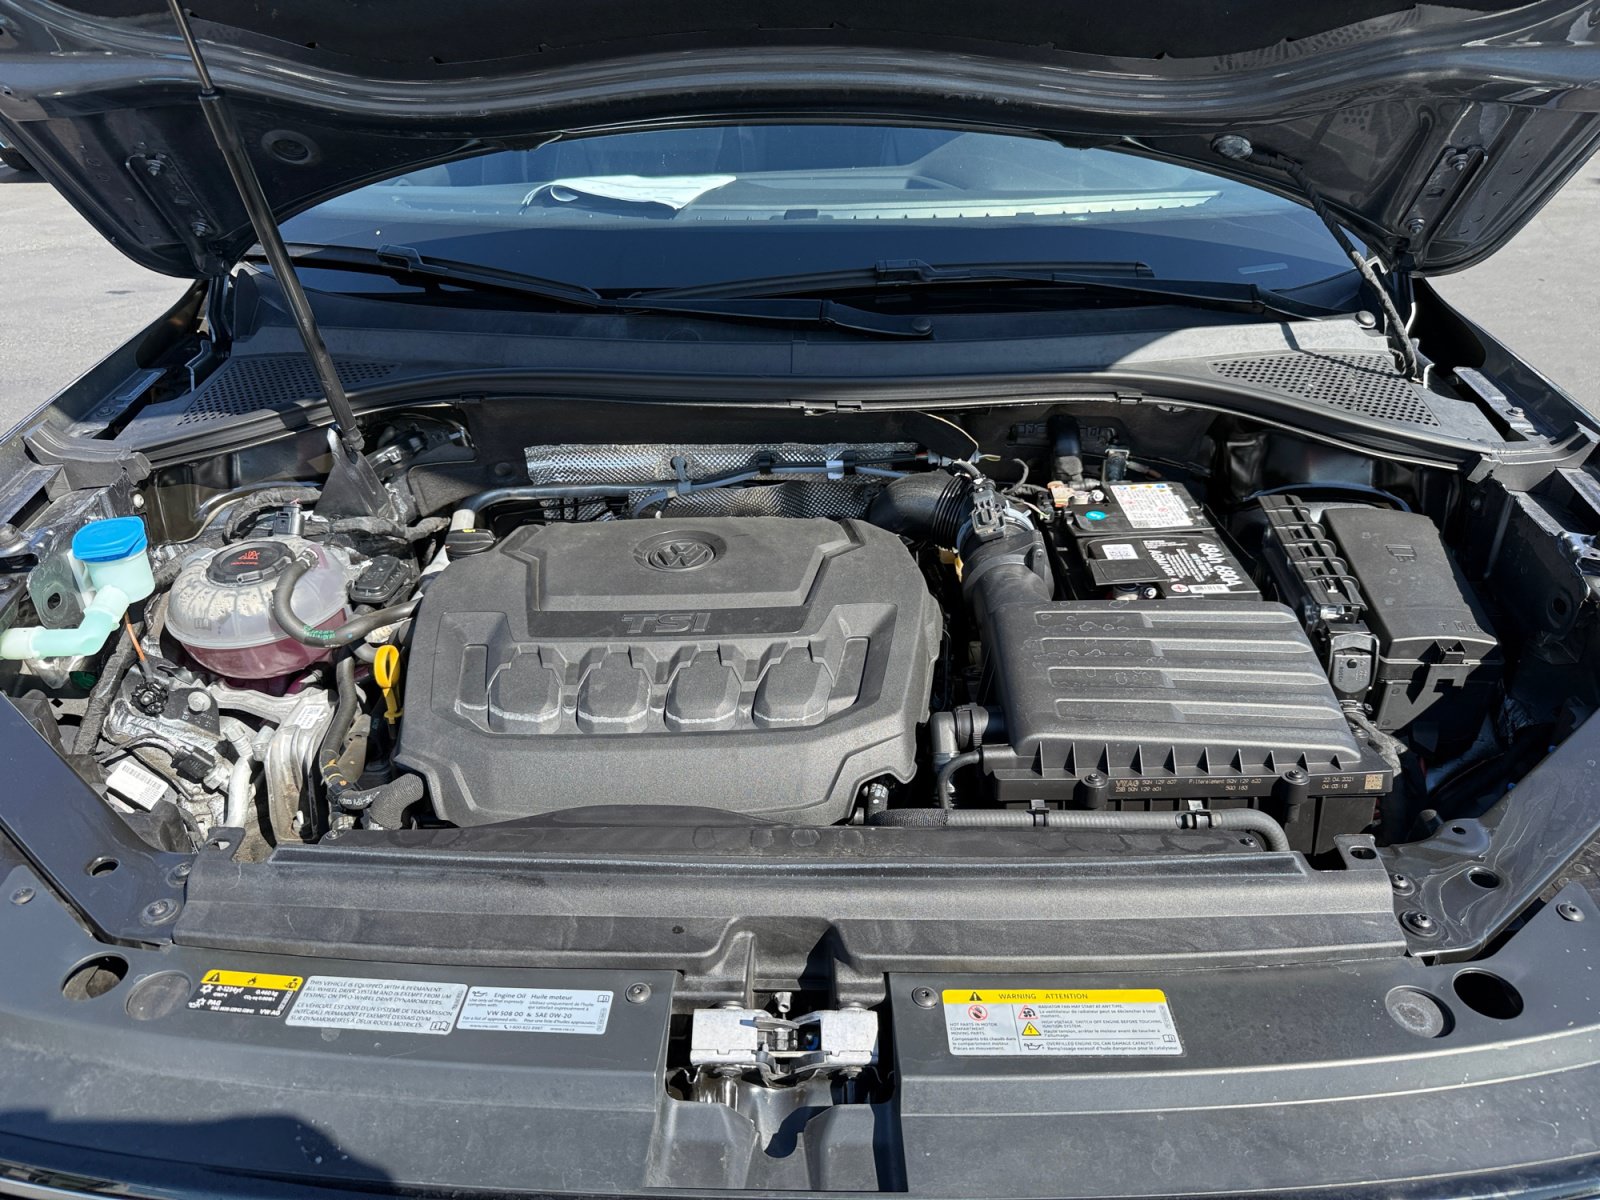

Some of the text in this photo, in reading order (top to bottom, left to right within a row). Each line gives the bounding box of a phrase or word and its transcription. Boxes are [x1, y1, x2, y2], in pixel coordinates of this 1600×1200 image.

[1197, 542, 1226, 564] 68Ah
[1214, 565, 1244, 586] 680A
[622, 613, 711, 633] TSI
